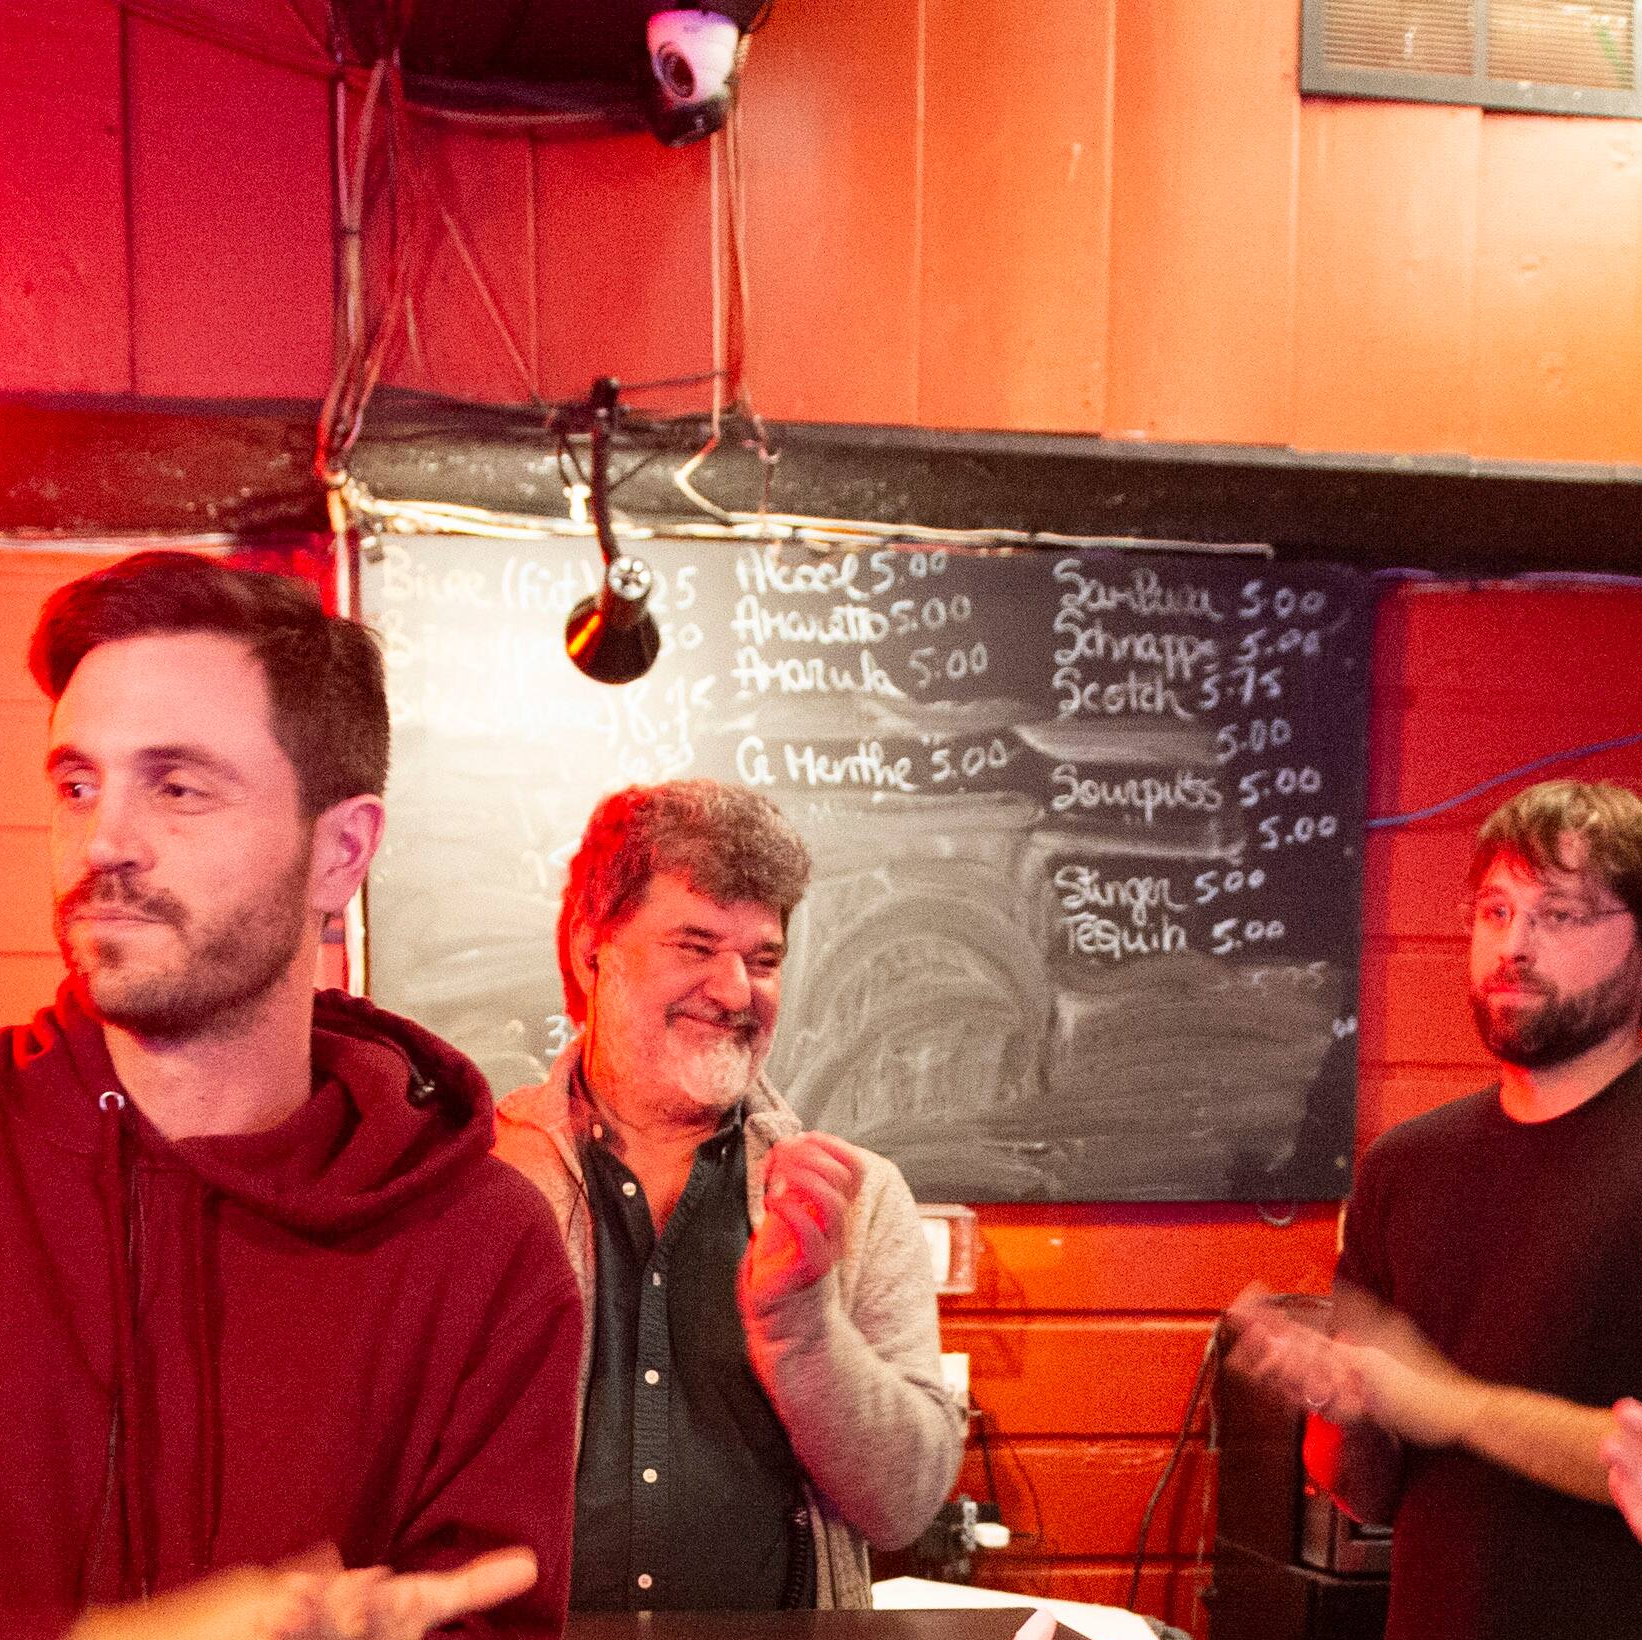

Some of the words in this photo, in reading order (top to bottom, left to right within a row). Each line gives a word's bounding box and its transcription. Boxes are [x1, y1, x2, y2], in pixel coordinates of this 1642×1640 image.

[889, 594, 972, 635] 5.00
[908, 641, 988, 688] 5.00
[1053, 667, 1194, 721] Scotch
[1200, 666, 1282, 710] 5.75
[1217, 719, 1291, 766] 5.00
[784, 742, 918, 791] Menthe
[931, 739, 1008, 783] 5.00
[1240, 766, 1322, 807] 5.00
[1259, 815, 1337, 850] 5.00
[1213, 918, 1285, 955] 5.00
